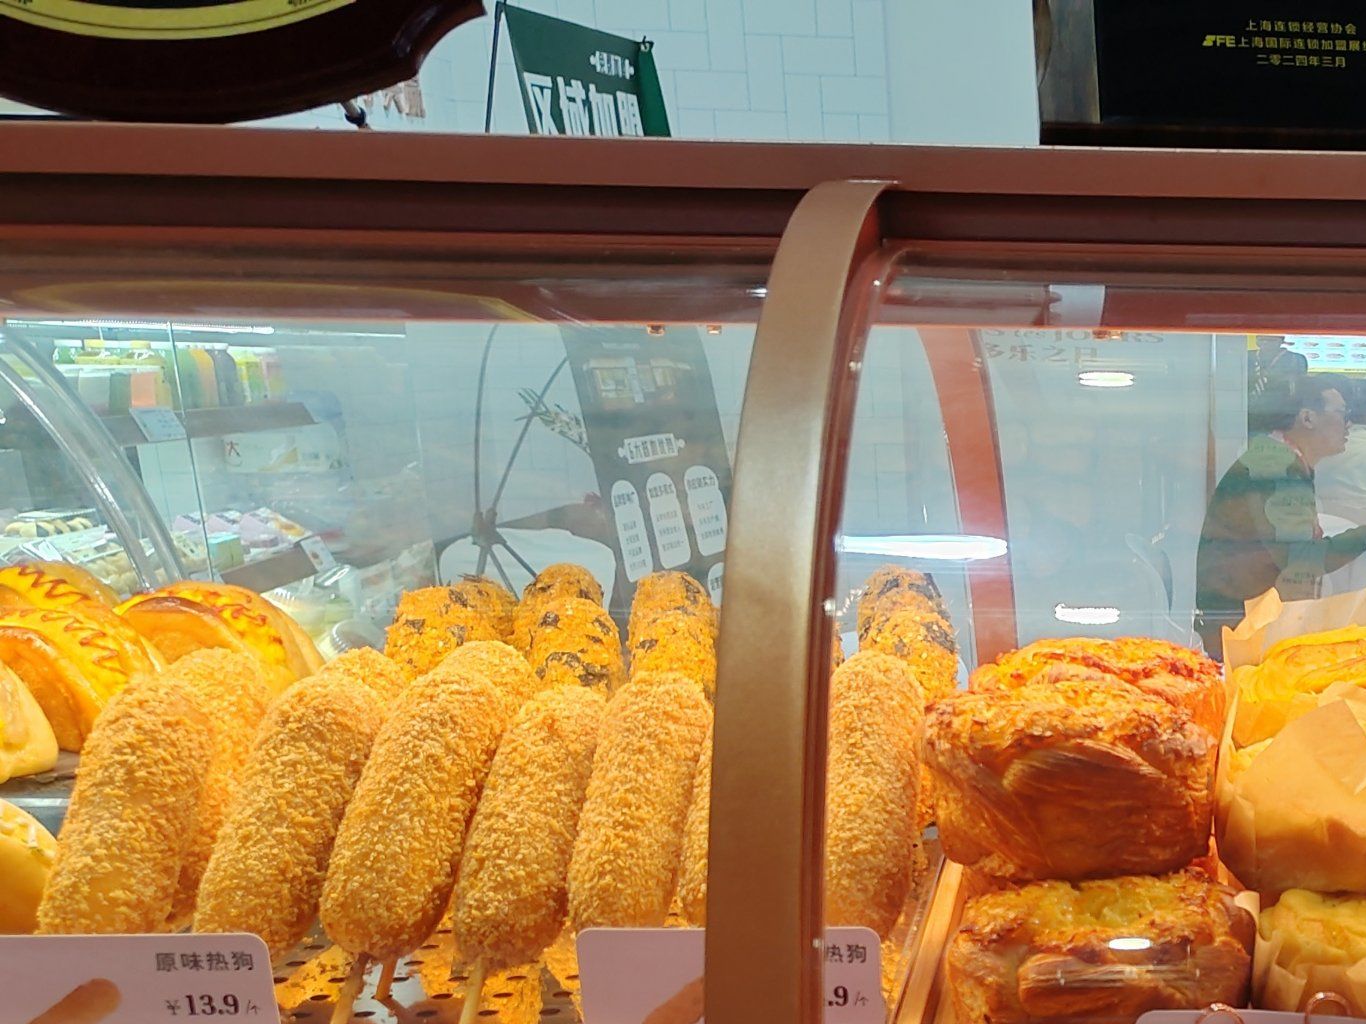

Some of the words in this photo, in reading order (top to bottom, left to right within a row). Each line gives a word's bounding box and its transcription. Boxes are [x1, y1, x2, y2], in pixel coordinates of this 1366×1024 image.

[1245, 19, 1357, 35] 上海连锁经营协会
[1256, 54, 1346, 68] 二零二四年三月
[155, 951, 254, 972] 原味热狗
